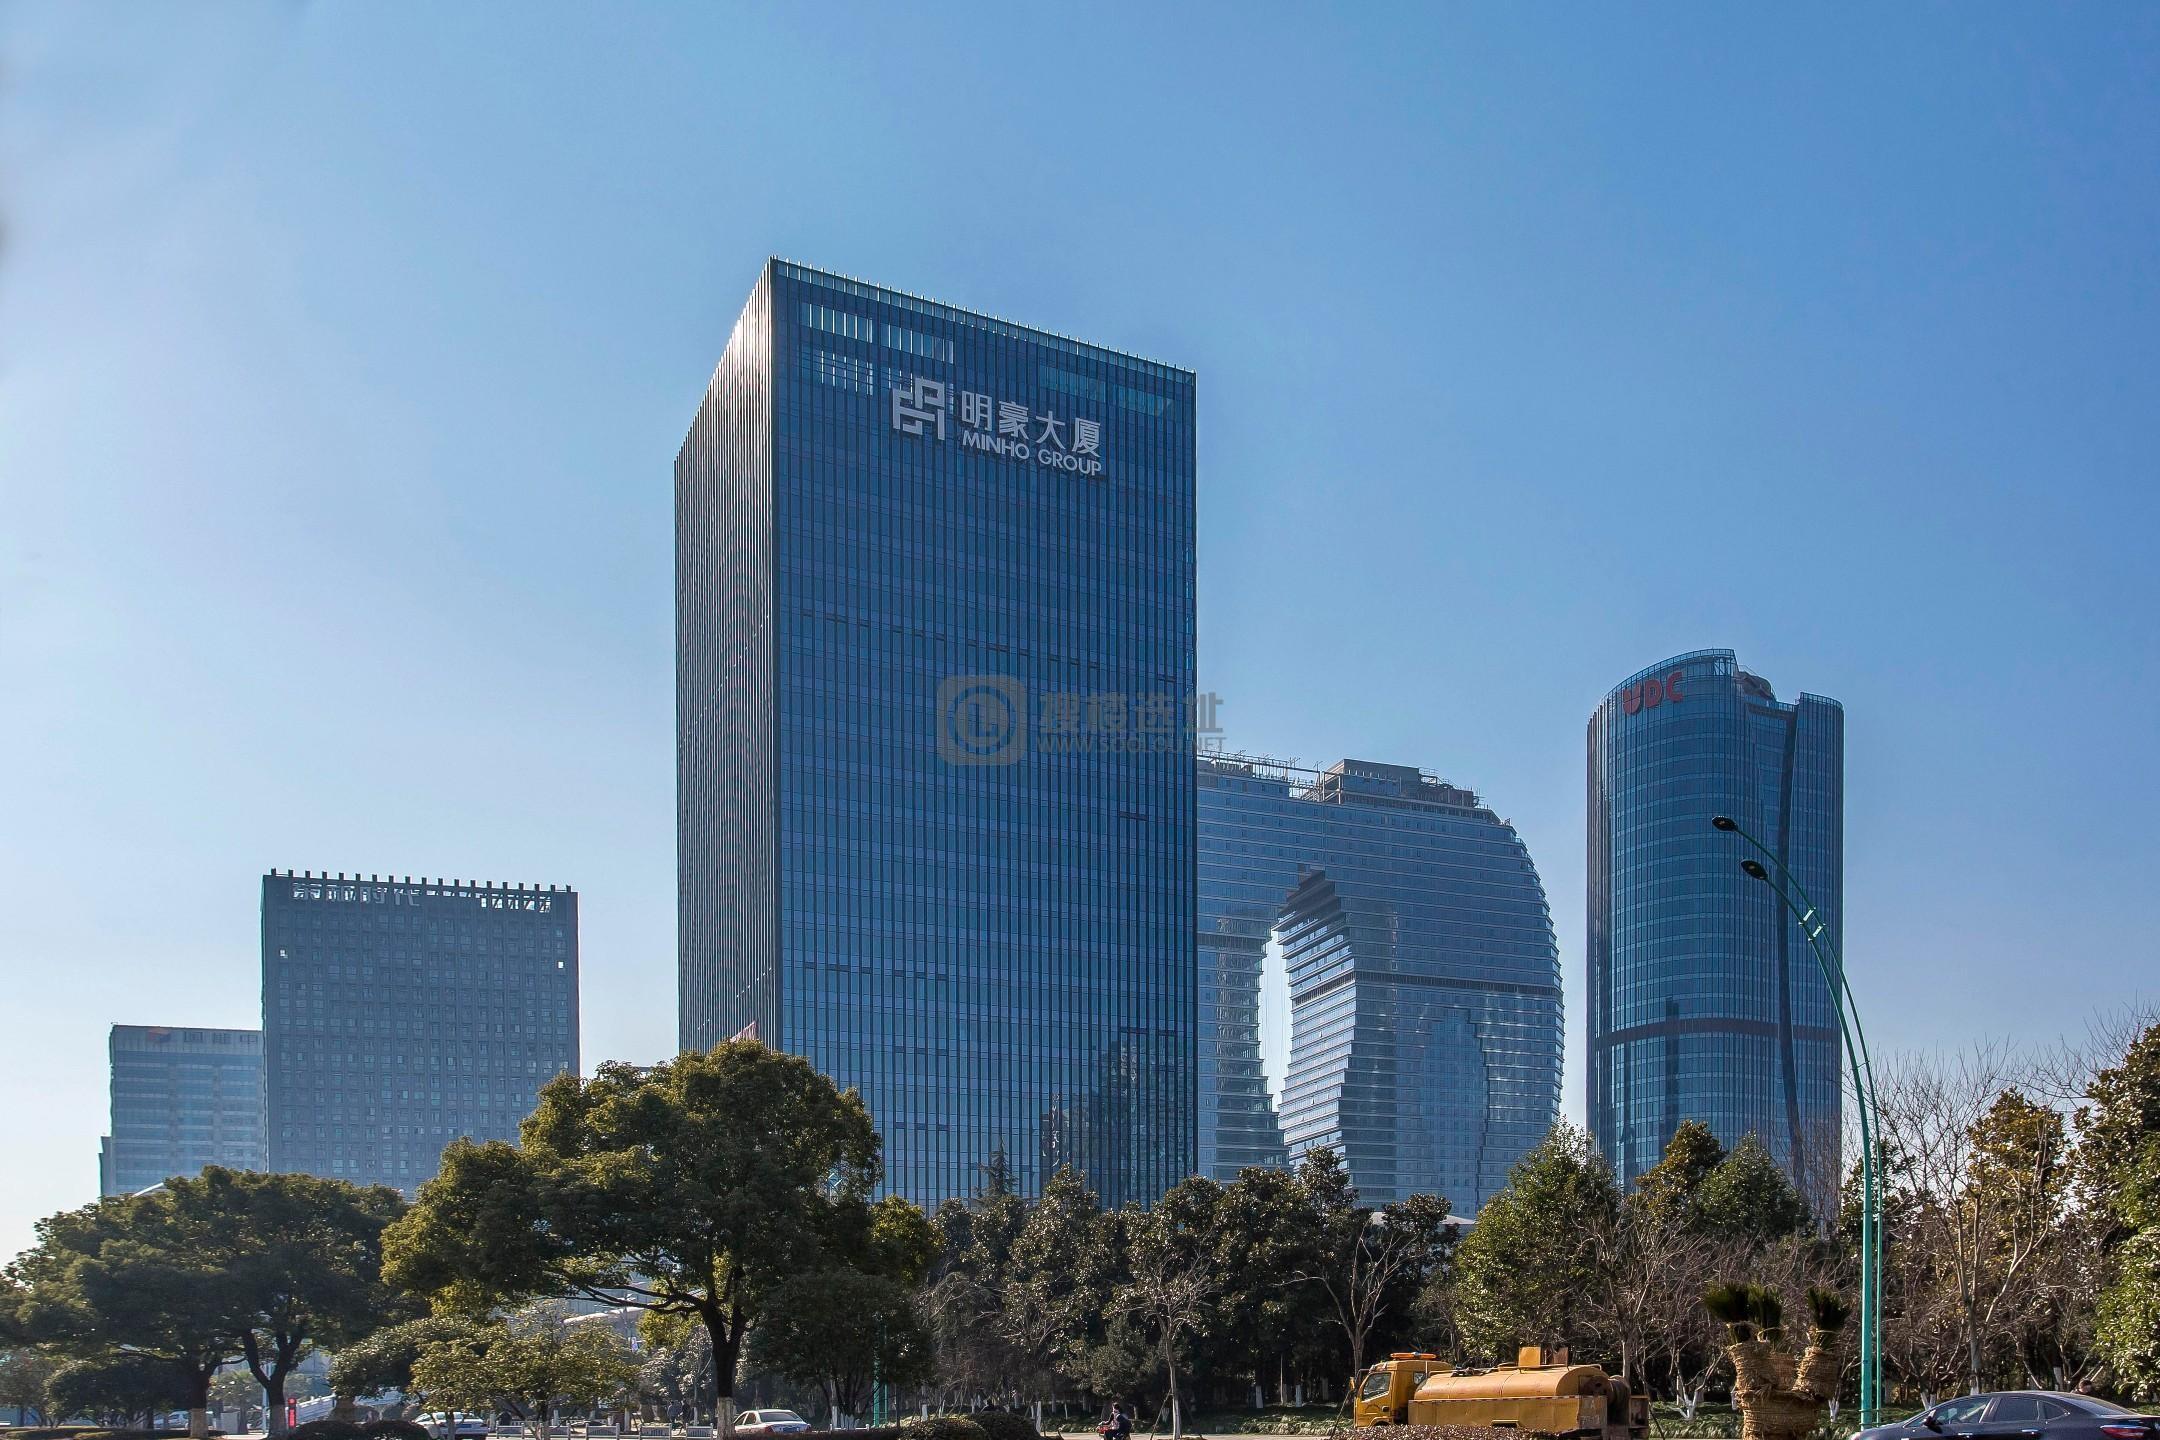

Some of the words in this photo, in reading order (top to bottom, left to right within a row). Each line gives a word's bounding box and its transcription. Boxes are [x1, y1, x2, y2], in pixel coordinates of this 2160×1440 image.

[961, 389, 1101, 458] 明豪大厦
[962, 430, 1030, 460] MINHO
[1037, 449, 1102, 476] GROUP
[1622, 671, 1684, 716] UDC
